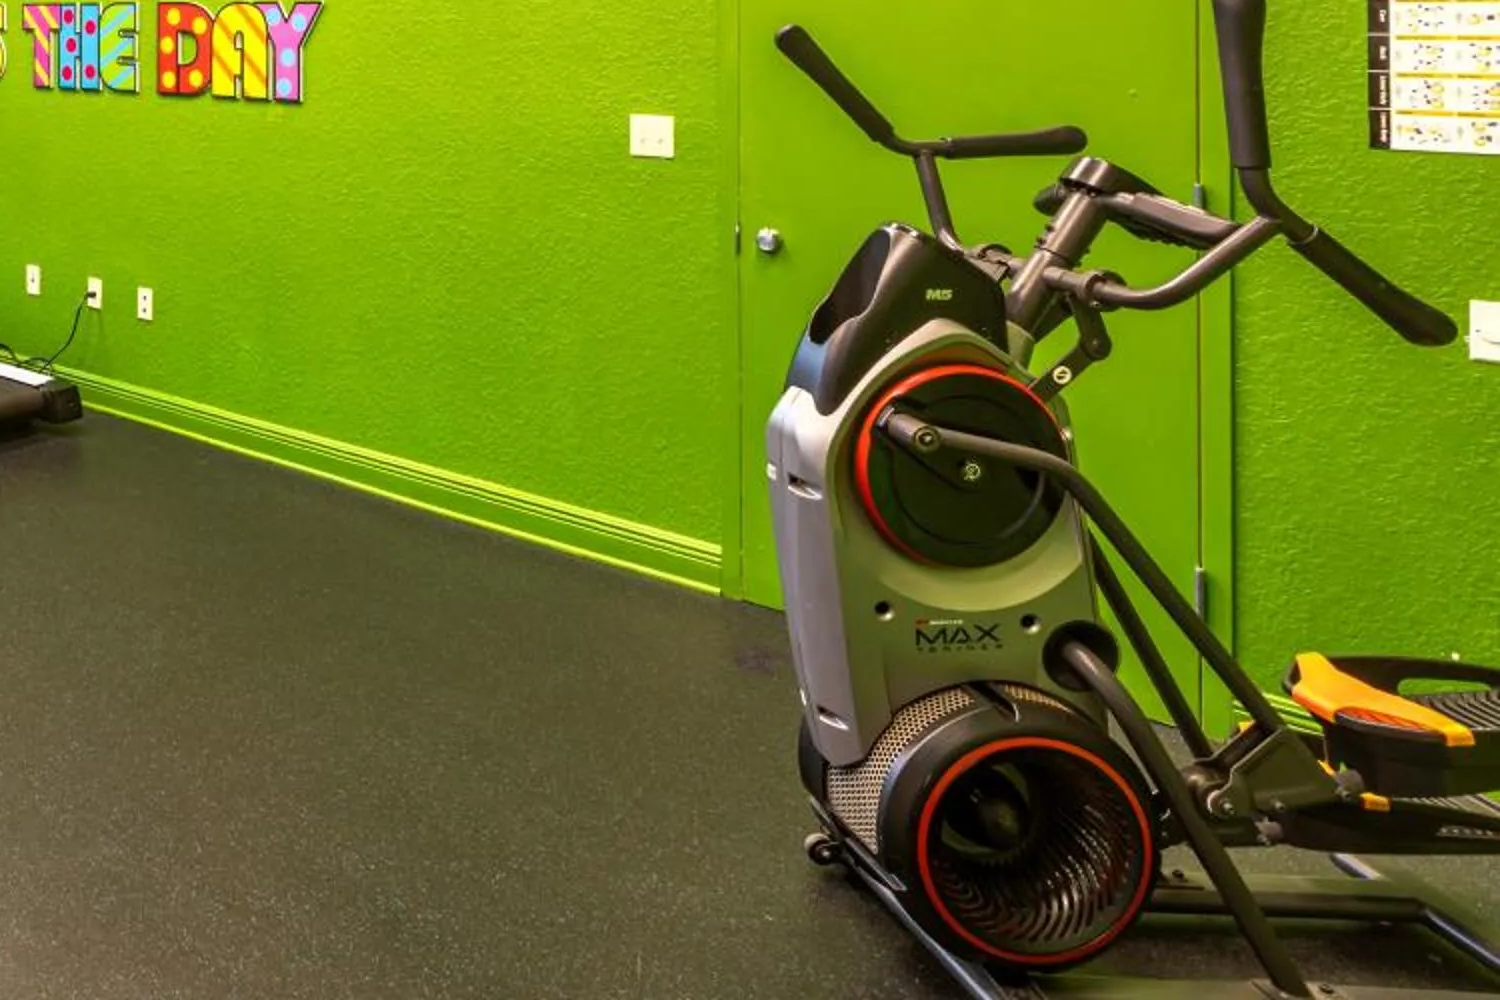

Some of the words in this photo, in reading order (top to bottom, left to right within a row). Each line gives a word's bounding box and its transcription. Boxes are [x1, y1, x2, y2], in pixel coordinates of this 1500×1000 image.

[22, 2, 140, 92] THE
[156, 1, 325, 104] DAY
[915, 623, 1002, 646] MAX
